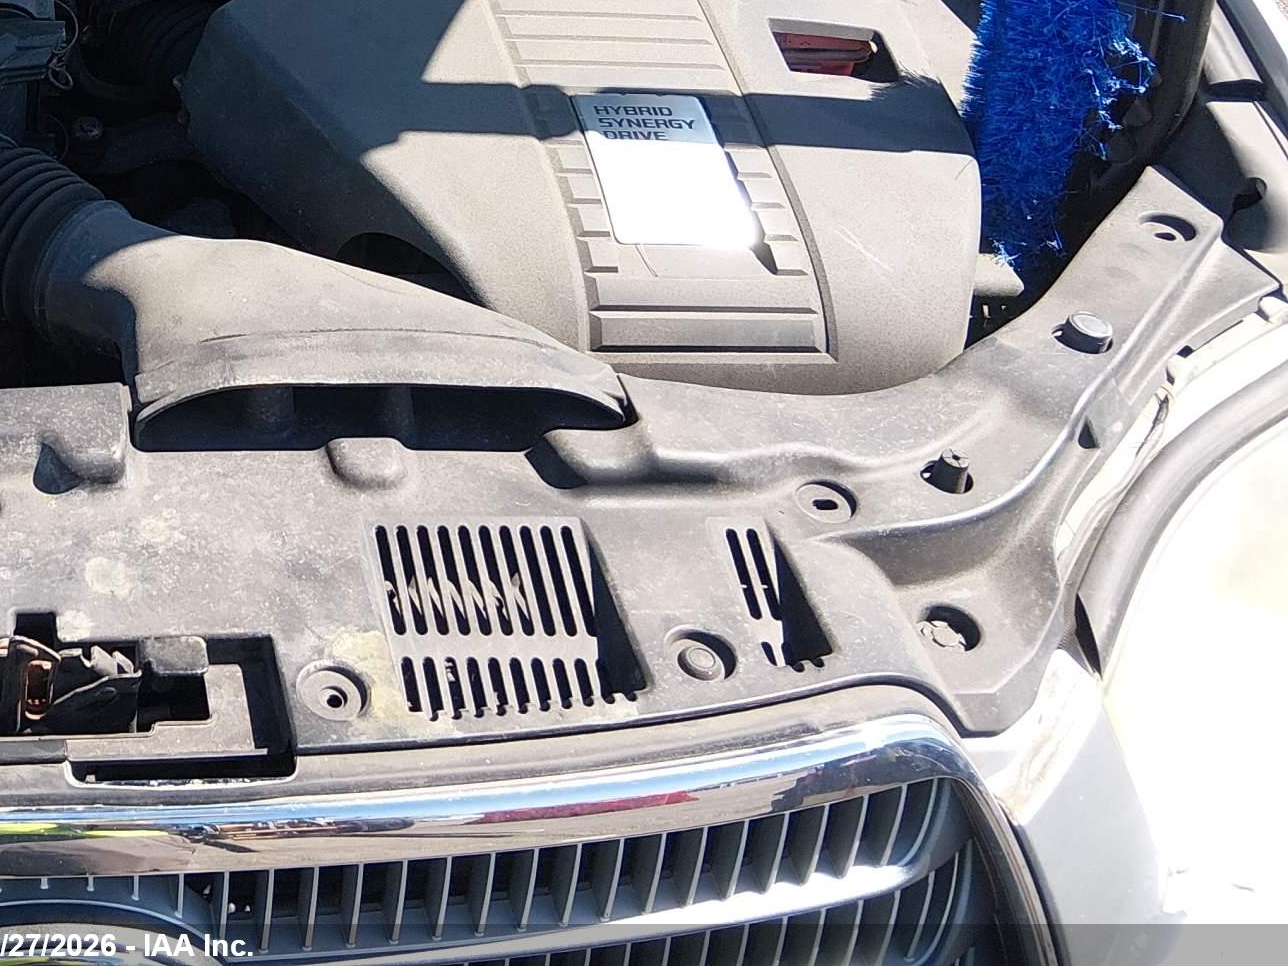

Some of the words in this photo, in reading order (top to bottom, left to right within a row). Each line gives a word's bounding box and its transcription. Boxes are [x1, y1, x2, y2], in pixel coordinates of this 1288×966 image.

[592, 105, 673, 117] HYBRID
[598, 117, 696, 130] SYNERGY
[602, 130, 668, 141] DRIVE
